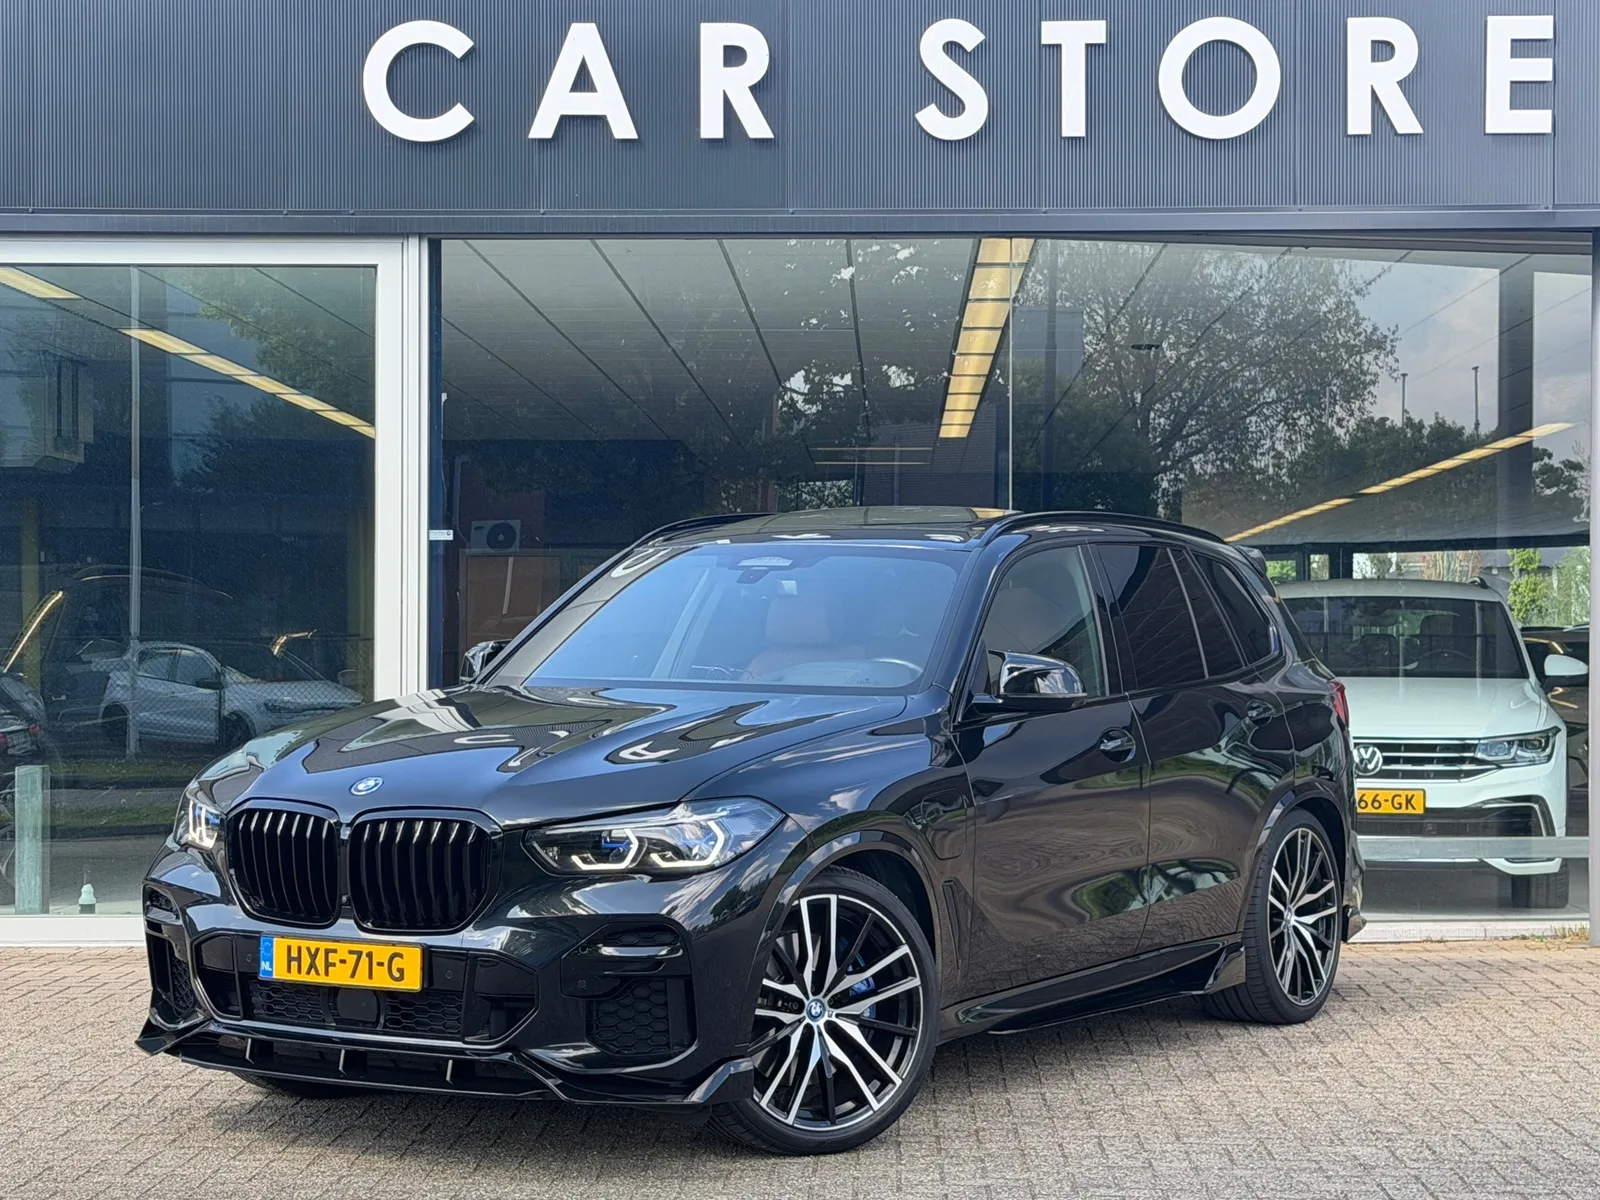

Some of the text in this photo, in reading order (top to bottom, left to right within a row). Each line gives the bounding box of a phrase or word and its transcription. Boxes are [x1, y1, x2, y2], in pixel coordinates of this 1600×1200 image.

[363, 15, 1554, 142] CAR STORE
[260, 960, 273, 972] NL
[286, 944, 404, 982] HXF-71-G
